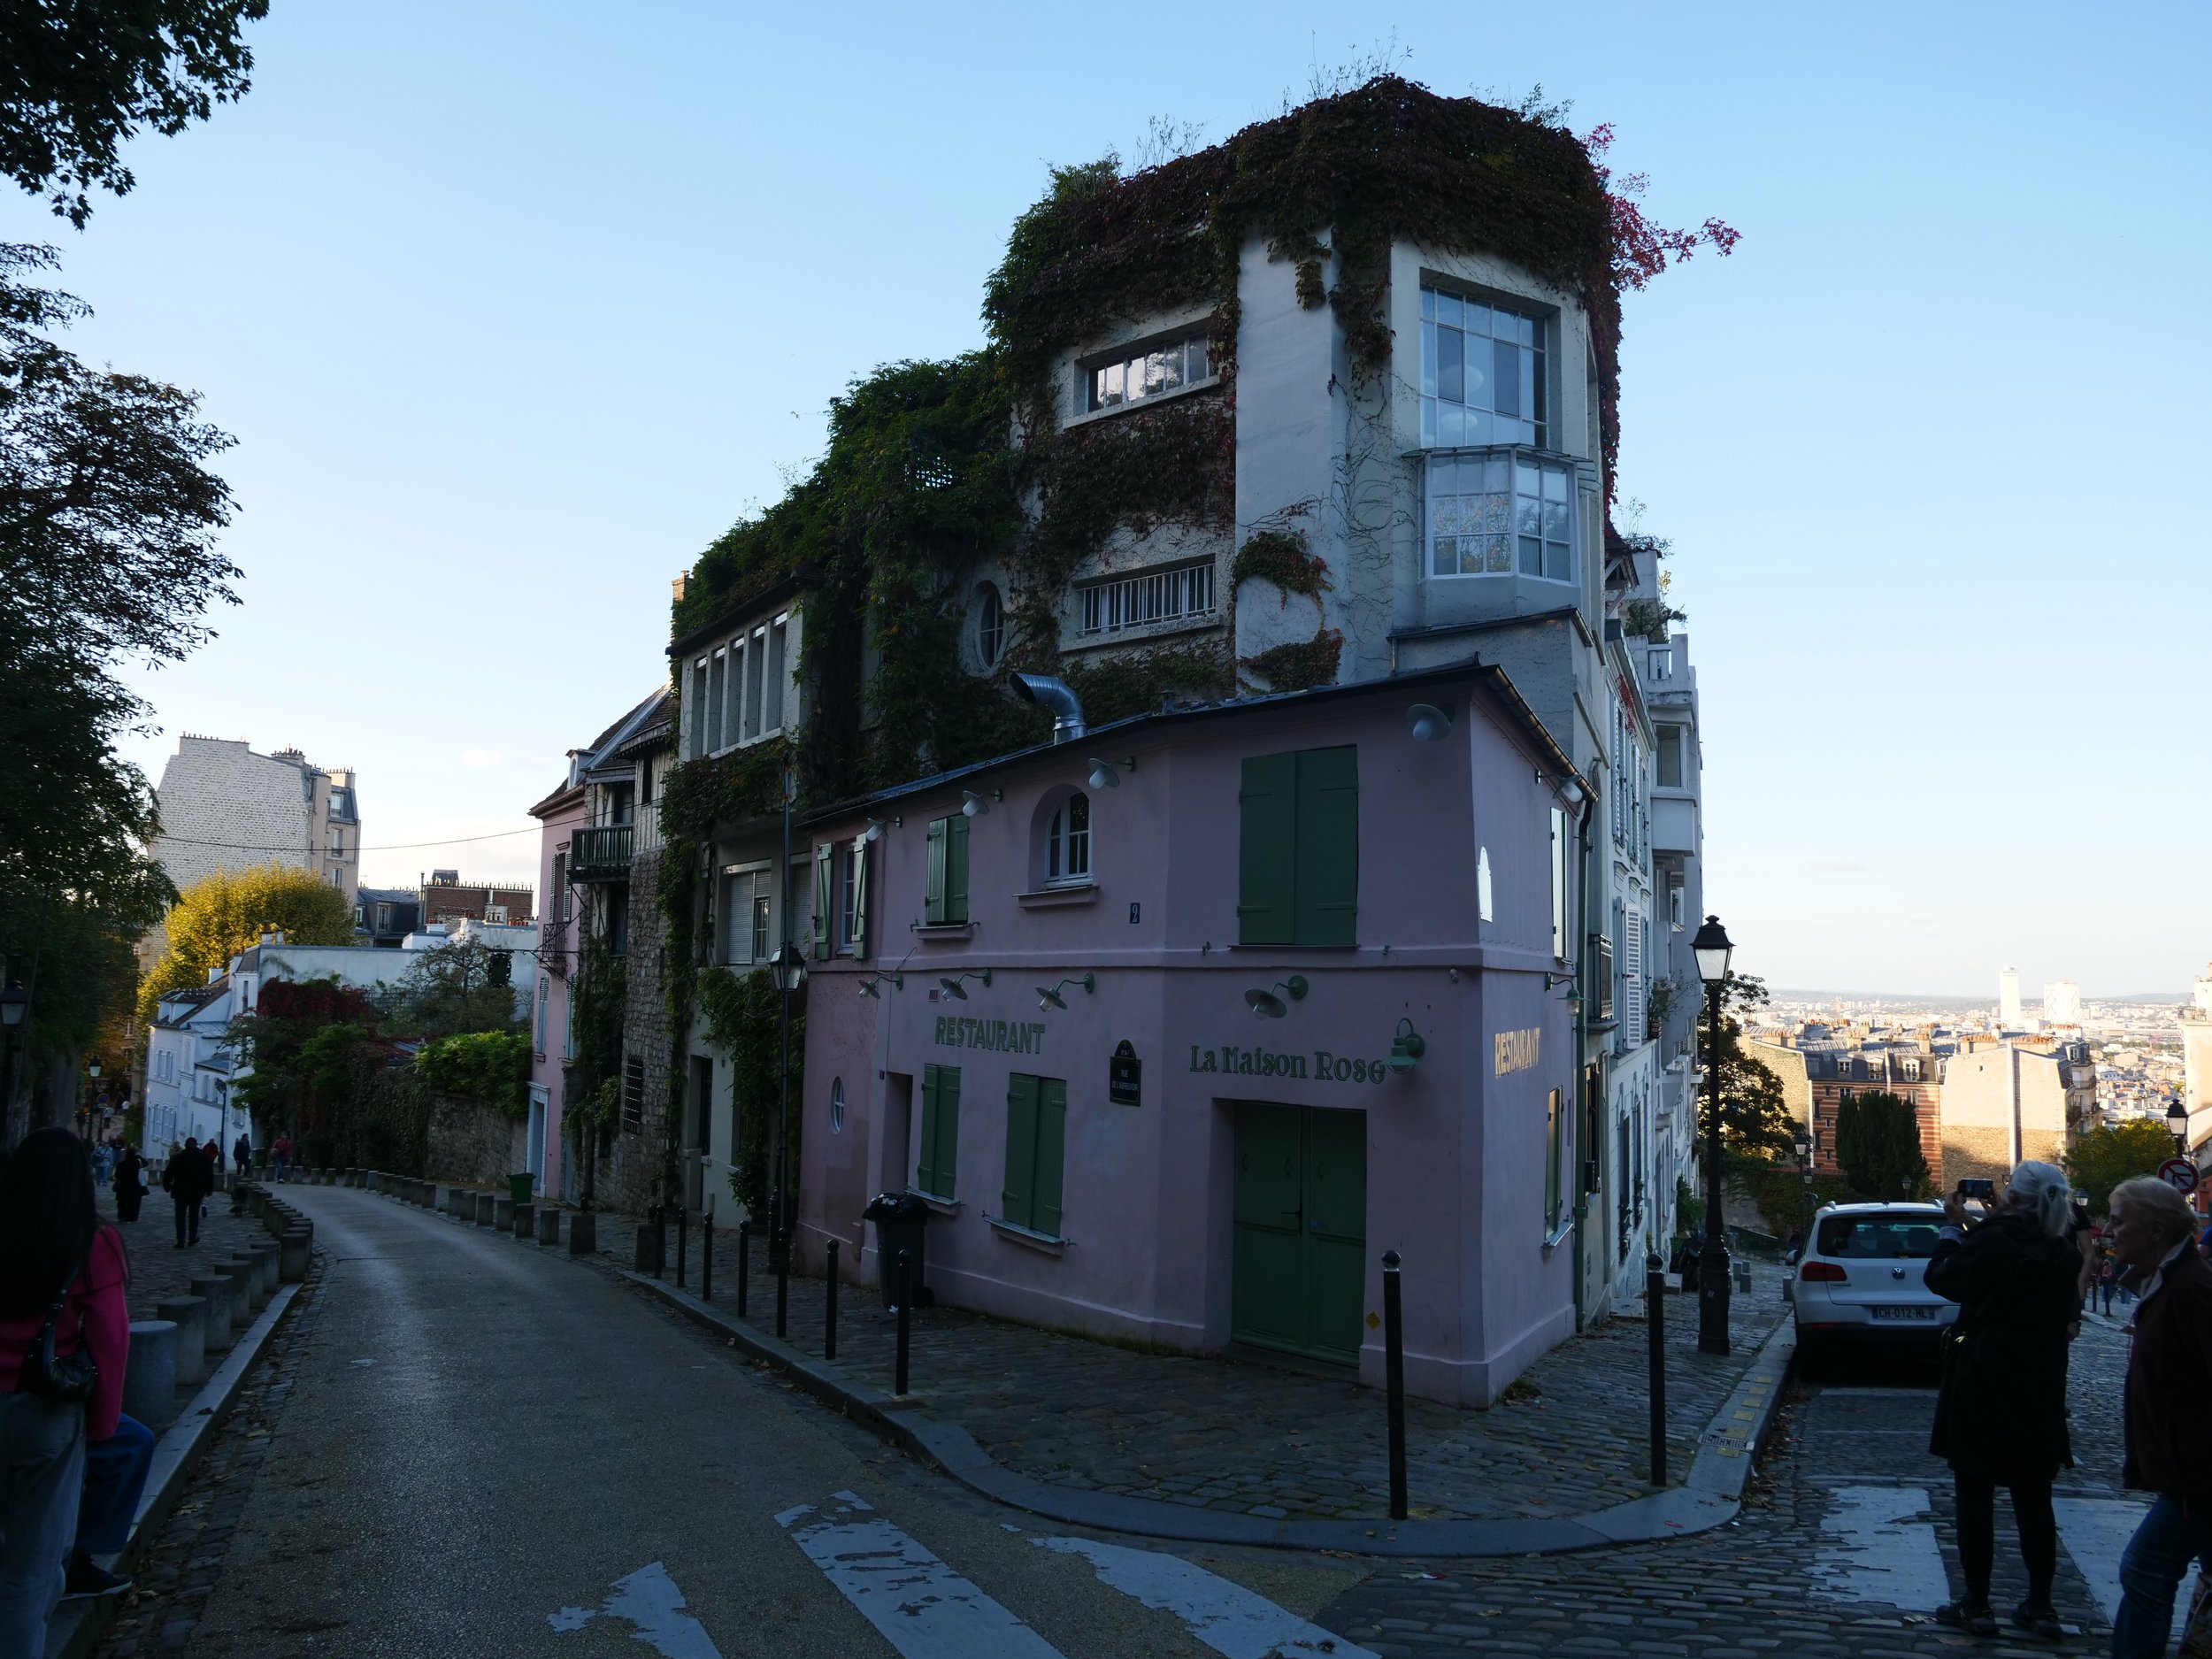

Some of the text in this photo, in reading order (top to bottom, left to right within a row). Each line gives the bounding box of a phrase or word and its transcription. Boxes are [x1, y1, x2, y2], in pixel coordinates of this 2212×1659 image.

[1132, 904, 1138, 923] 2
[935, 1016, 1046, 1055] RESTAURANT
[1494, 1027, 1540, 1077] RESTAURANT
[1190, 1045, 1386, 1085] La Maison Rose
